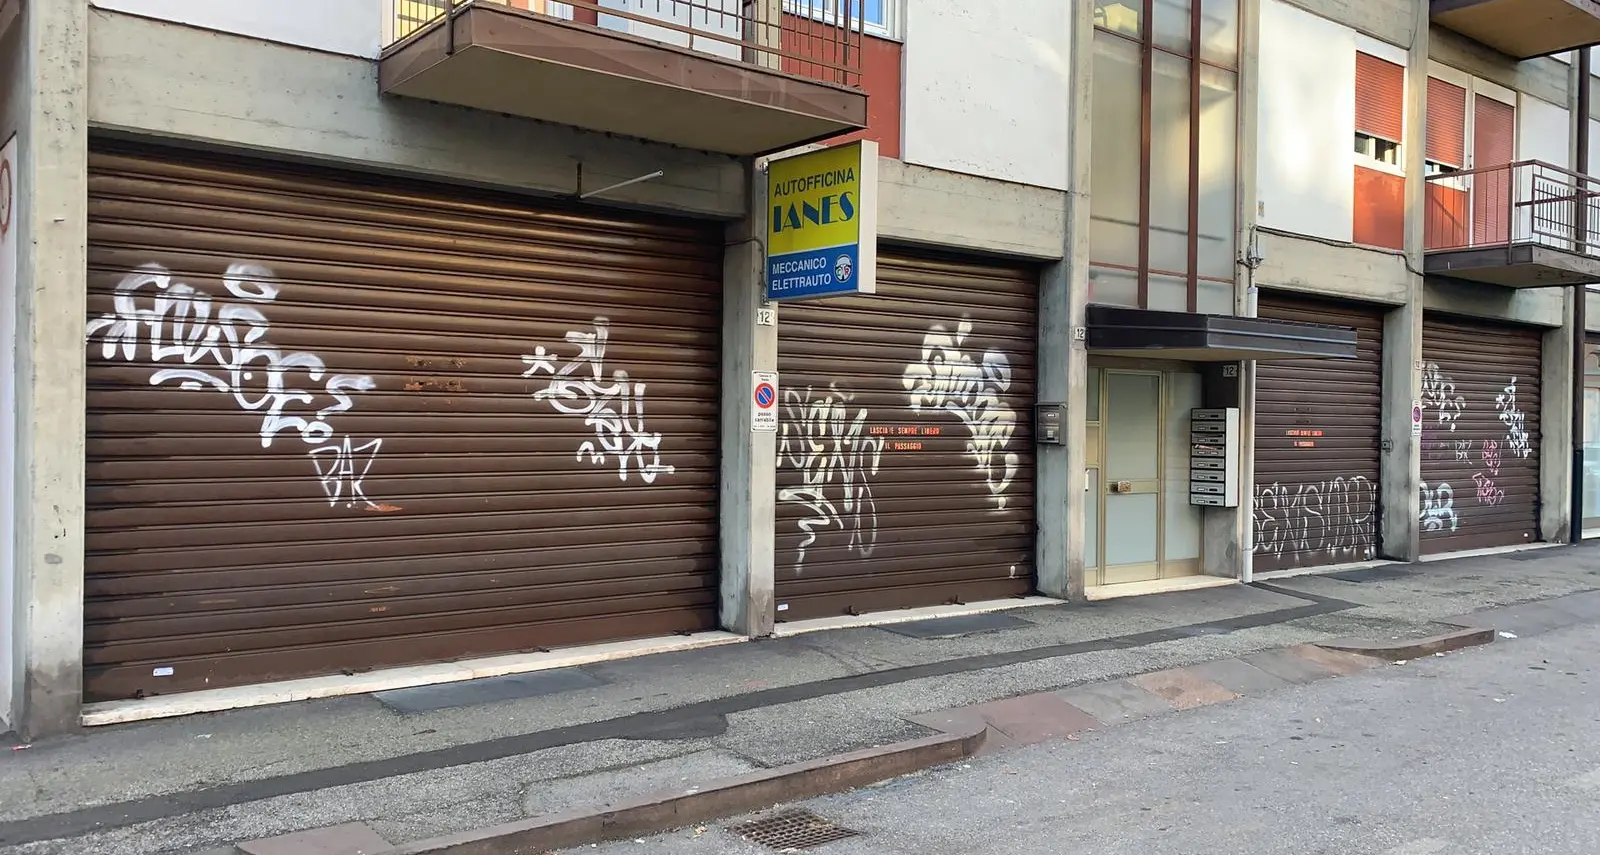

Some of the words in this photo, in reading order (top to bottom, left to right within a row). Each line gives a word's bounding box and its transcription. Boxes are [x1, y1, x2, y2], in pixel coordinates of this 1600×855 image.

[774, 167, 855, 197] AUTOFFICINA
[773, 191, 854, 233] IANES
[772, 257, 827, 275] MECCANICO
[772, 273, 831, 291] ELETTRAUTO
[759, 311, 770, 323] 12
[1077, 328, 1084, 339] 12
[1225, 366, 1234, 376] 12
[894, 442, 922, 450] PASSAGGIO
